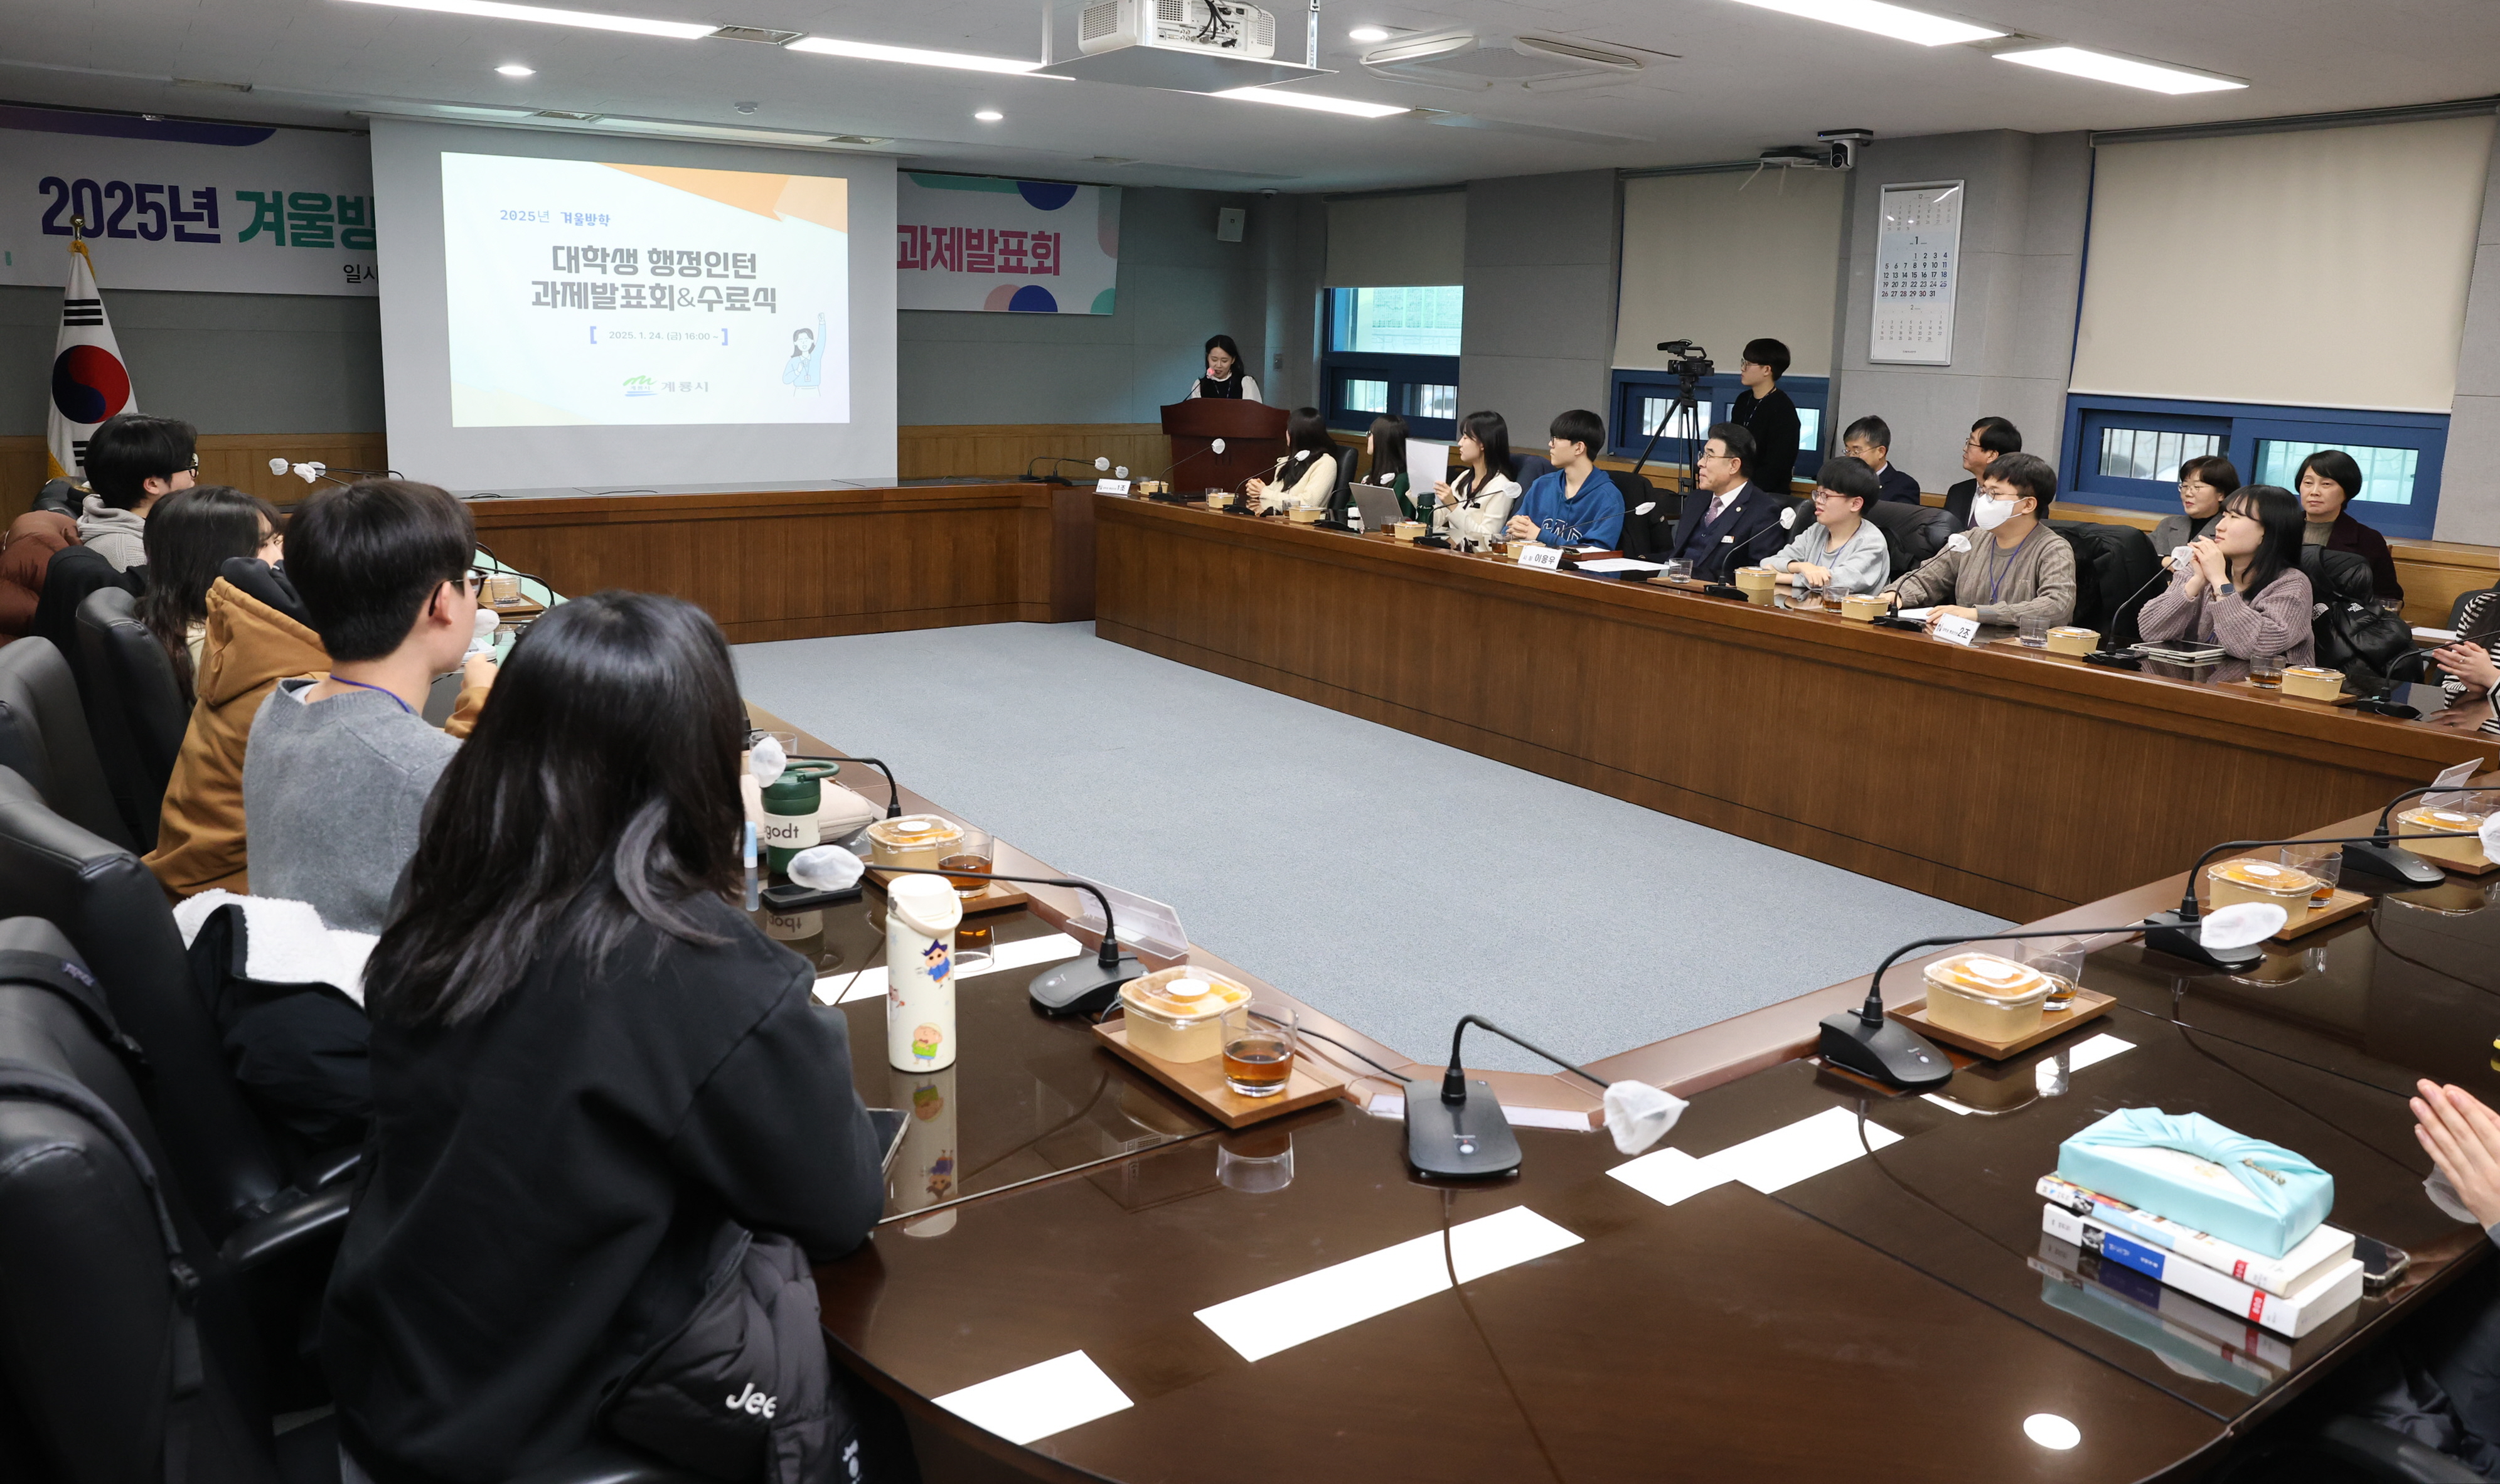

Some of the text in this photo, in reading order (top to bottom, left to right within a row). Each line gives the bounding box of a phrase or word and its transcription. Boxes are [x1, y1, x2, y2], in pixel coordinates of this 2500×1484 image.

[40, 176, 221, 243] 2025년
[500, 210, 611, 227] 2025년 겨울방학
[897, 224, 1060, 276] 과제발표회
[552, 245, 757, 280] 대학생 행정인턴
[343, 264, 379, 285] 일시
[532, 280, 777, 314] 과제발표회&수료식
[609, 331, 636, 339] 2025.
[639, 331, 646, 339] 1.
[648, 331, 664, 339] 24.
[666, 331, 682, 341] (금)
[685, 332, 710, 341] 16:00
[661, 381, 708, 393] 계룡시
[1534, 553, 1556, 565] 이응우
[1957, 627, 1971, 639] 2조
